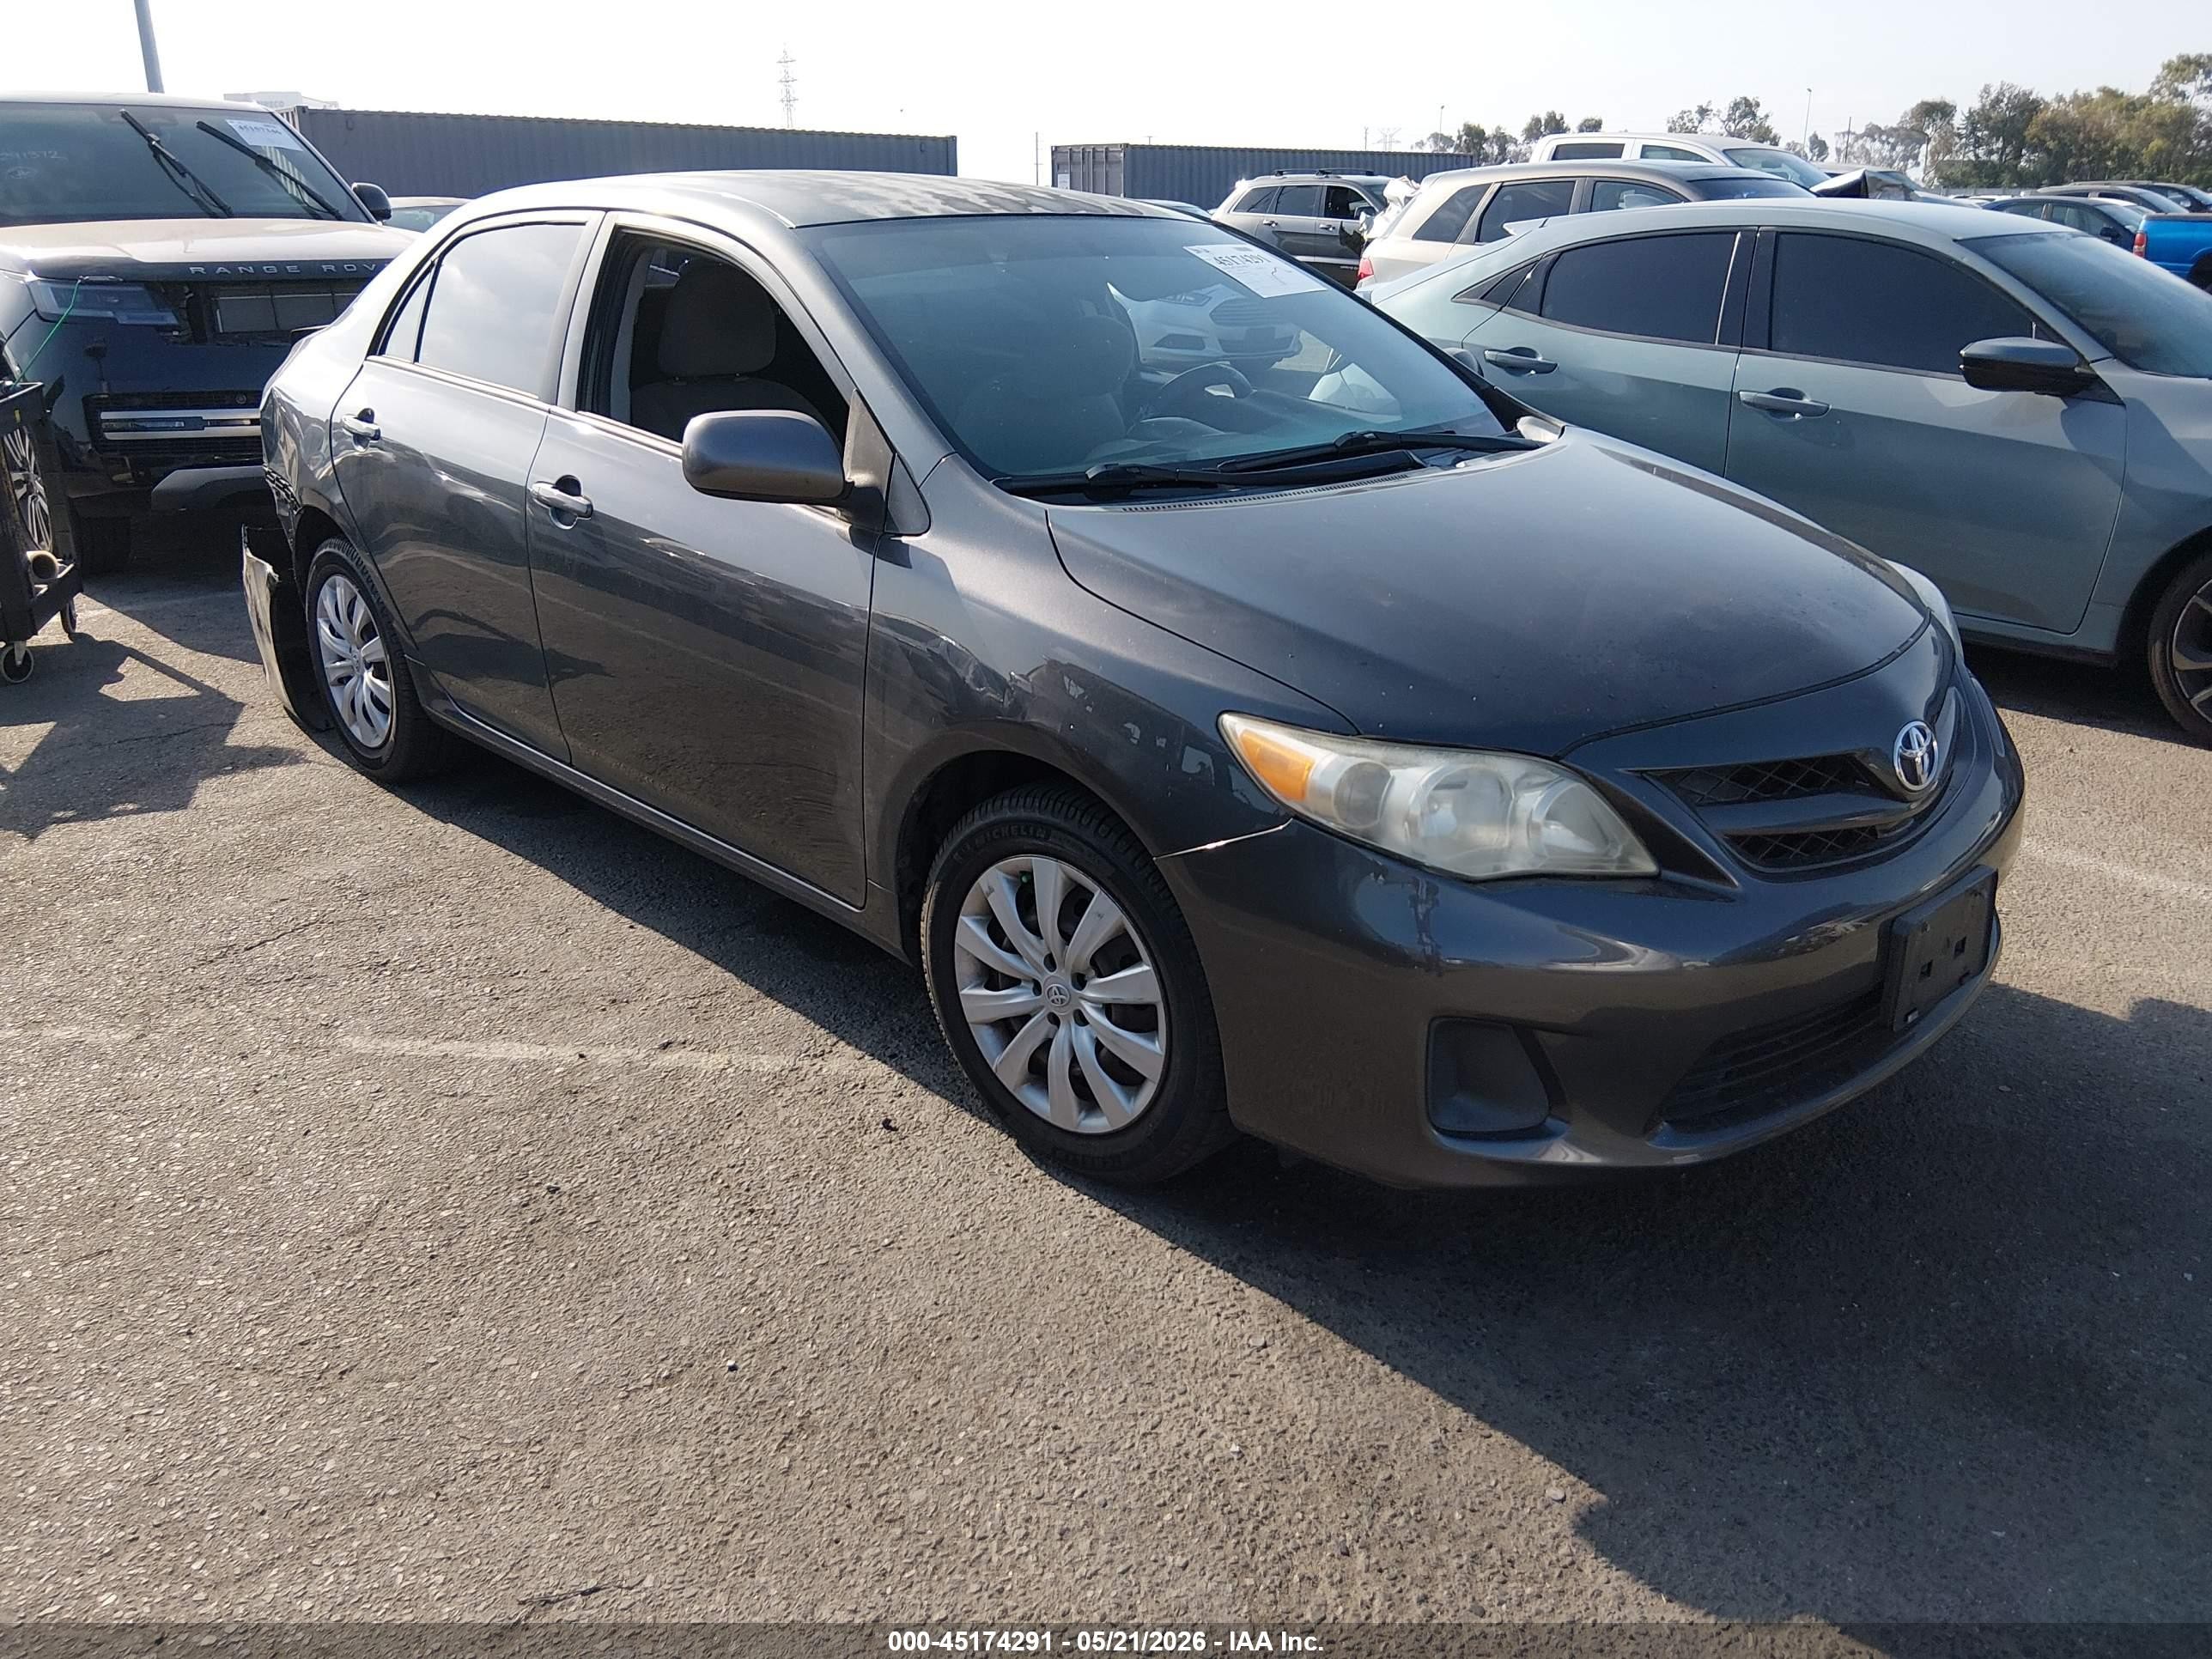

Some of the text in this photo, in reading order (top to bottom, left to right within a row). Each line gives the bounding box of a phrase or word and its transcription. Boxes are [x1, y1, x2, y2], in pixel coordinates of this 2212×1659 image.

[1212, 254, 1272, 266] 45174291
[189, 264, 388, 275] RANGE ROV
